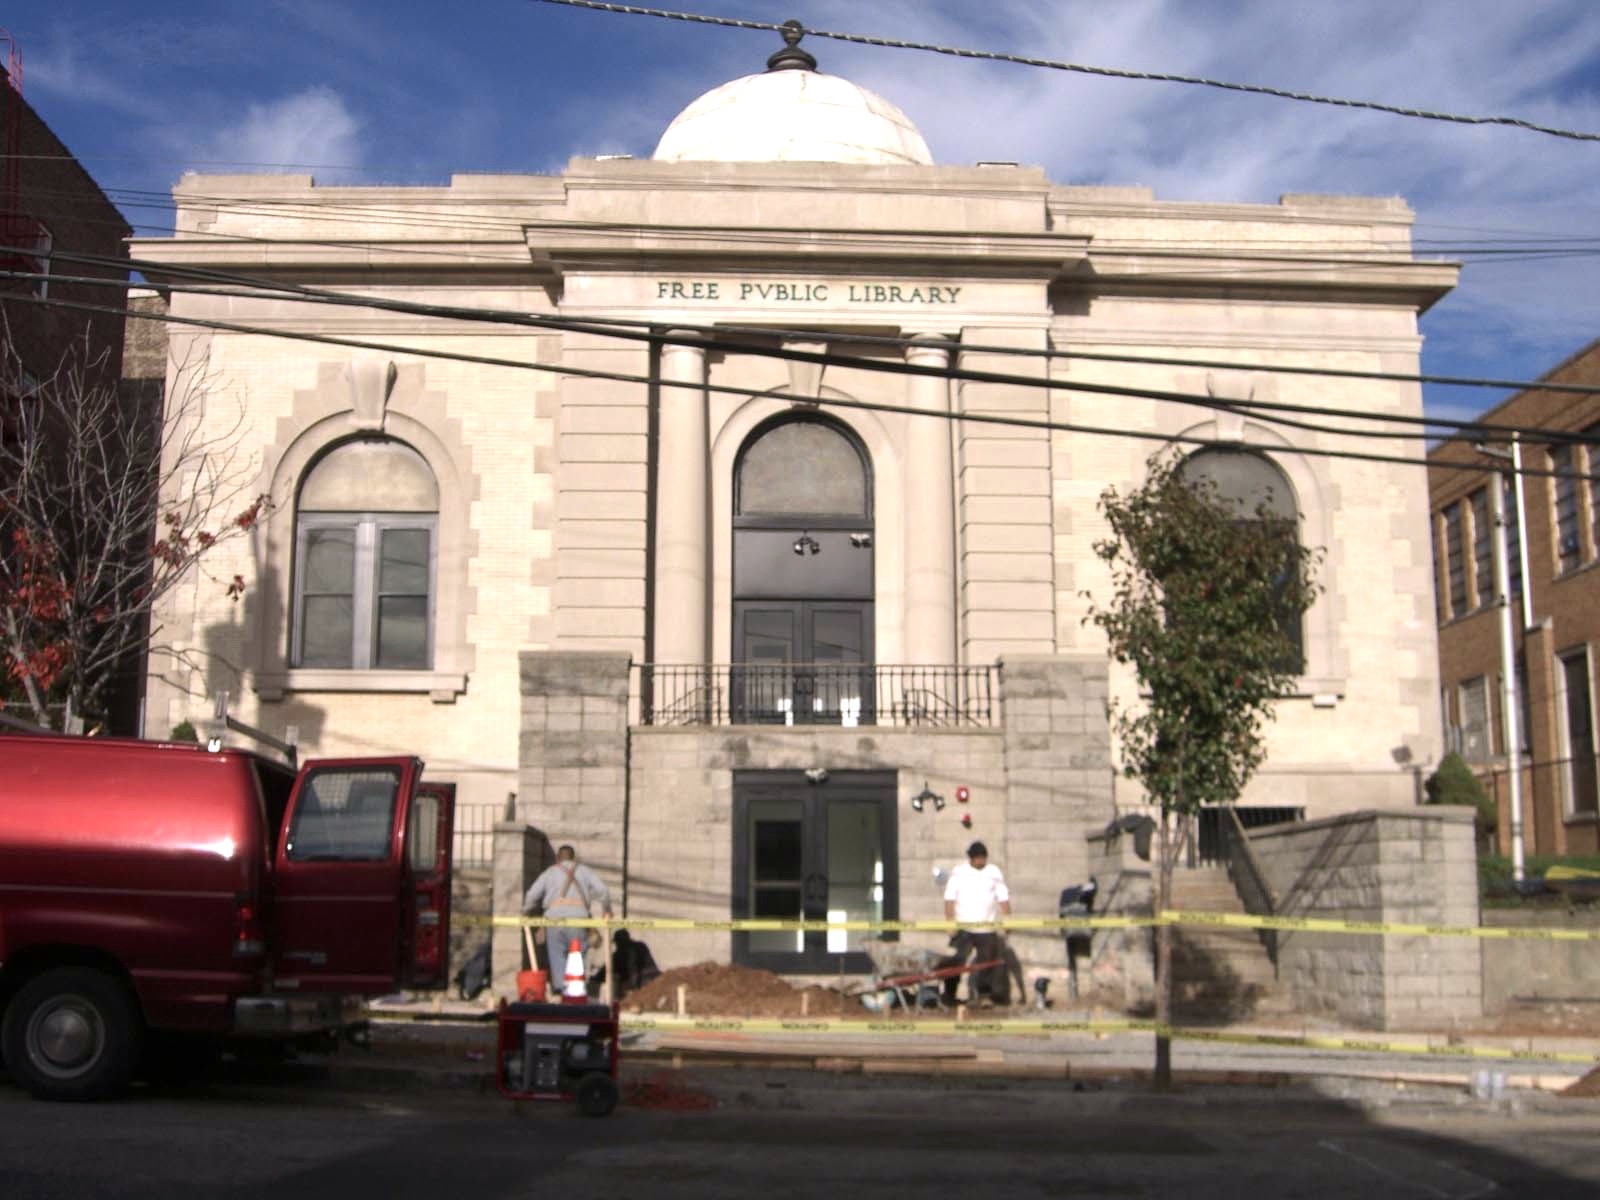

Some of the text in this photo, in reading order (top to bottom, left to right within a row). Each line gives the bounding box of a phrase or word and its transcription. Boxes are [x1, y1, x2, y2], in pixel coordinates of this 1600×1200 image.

[657, 281, 962, 304] FREE PVBLIC LIBRARY
